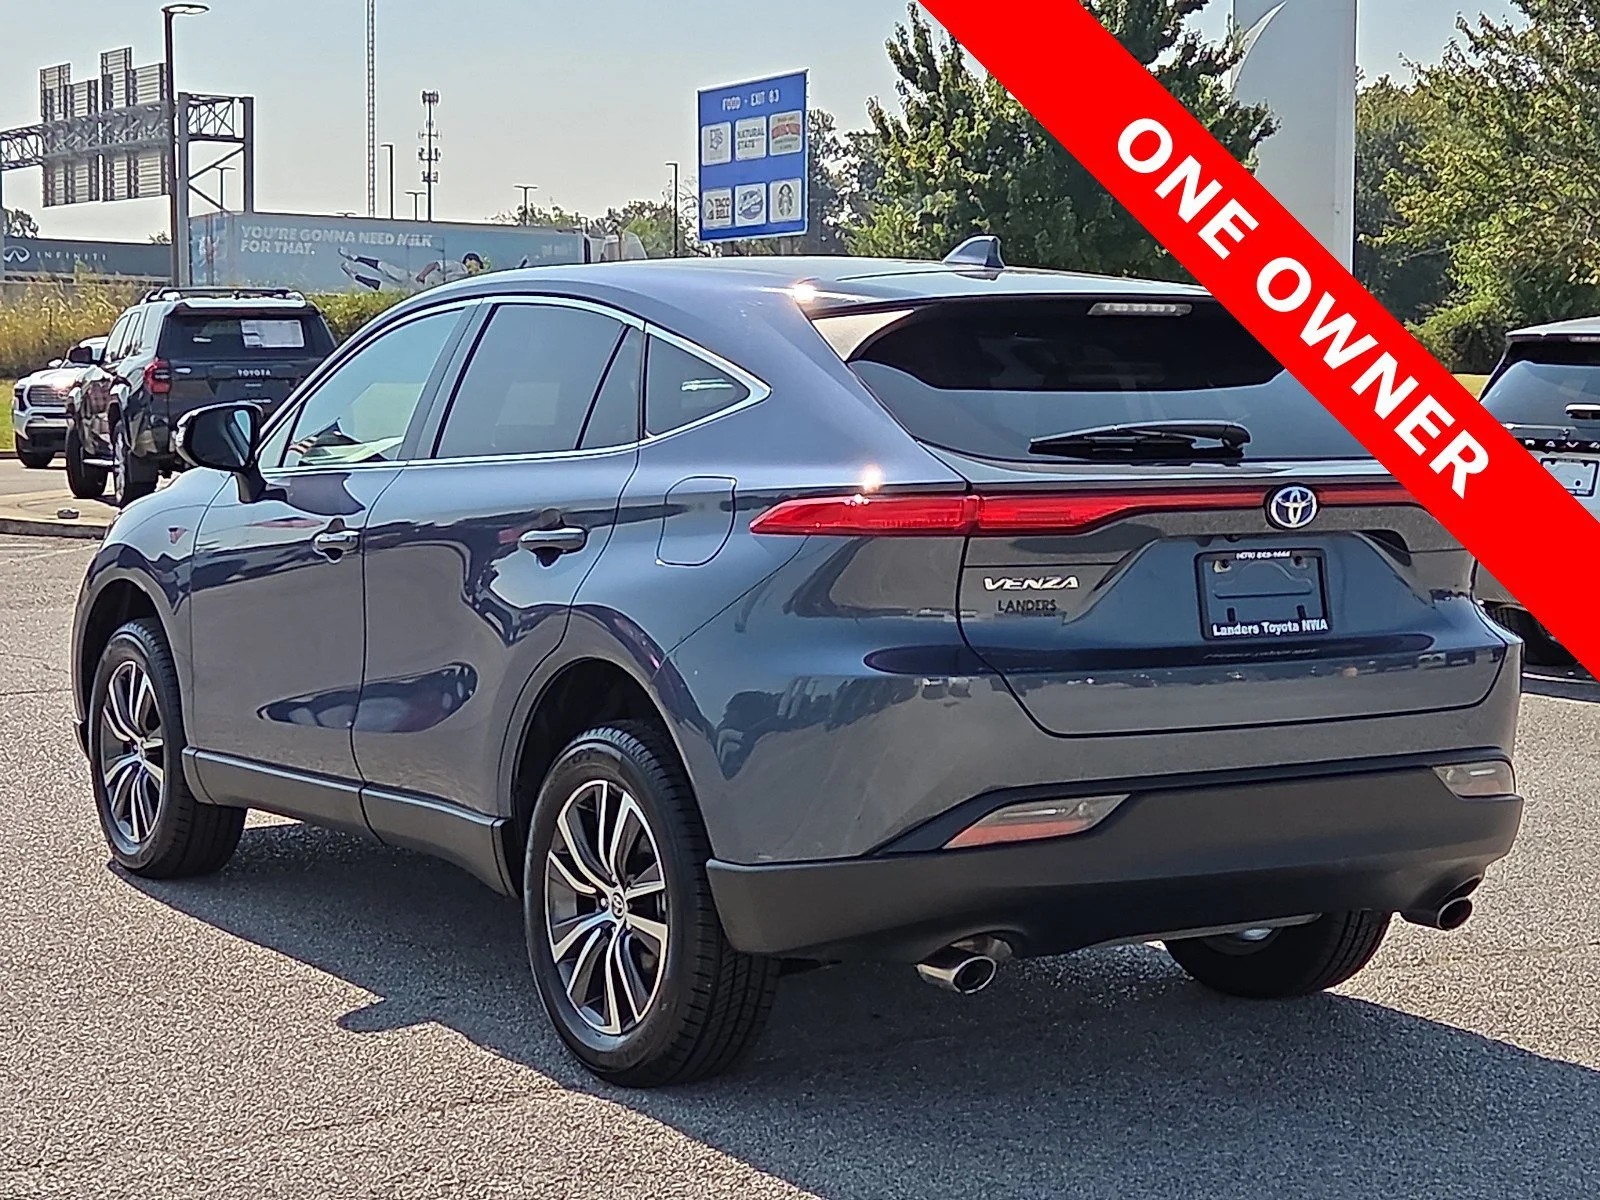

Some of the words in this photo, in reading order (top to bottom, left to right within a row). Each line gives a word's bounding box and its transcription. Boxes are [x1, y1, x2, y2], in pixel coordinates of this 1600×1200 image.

[751, 91, 765, 106] EXIT
[241, 224, 297, 240] YOU'RE
[300, 229, 355, 243] GONNA
[359, 231, 395, 245] NEED
[397, 233, 433, 247] MILK
[241, 240, 270, 252] FOR
[274, 241, 315, 255] THAT.
[36, 251, 106, 261] INFINITI
[237, 368, 271, 377] TOYOTA
[983, 576, 1079, 591] VENZA
[997, 599, 1058, 613] LANDERS
[1212, 622, 1260, 637] Landers
[1261, 620, 1299, 636] Toyota
[1301, 618, 1328, 632] NWA
